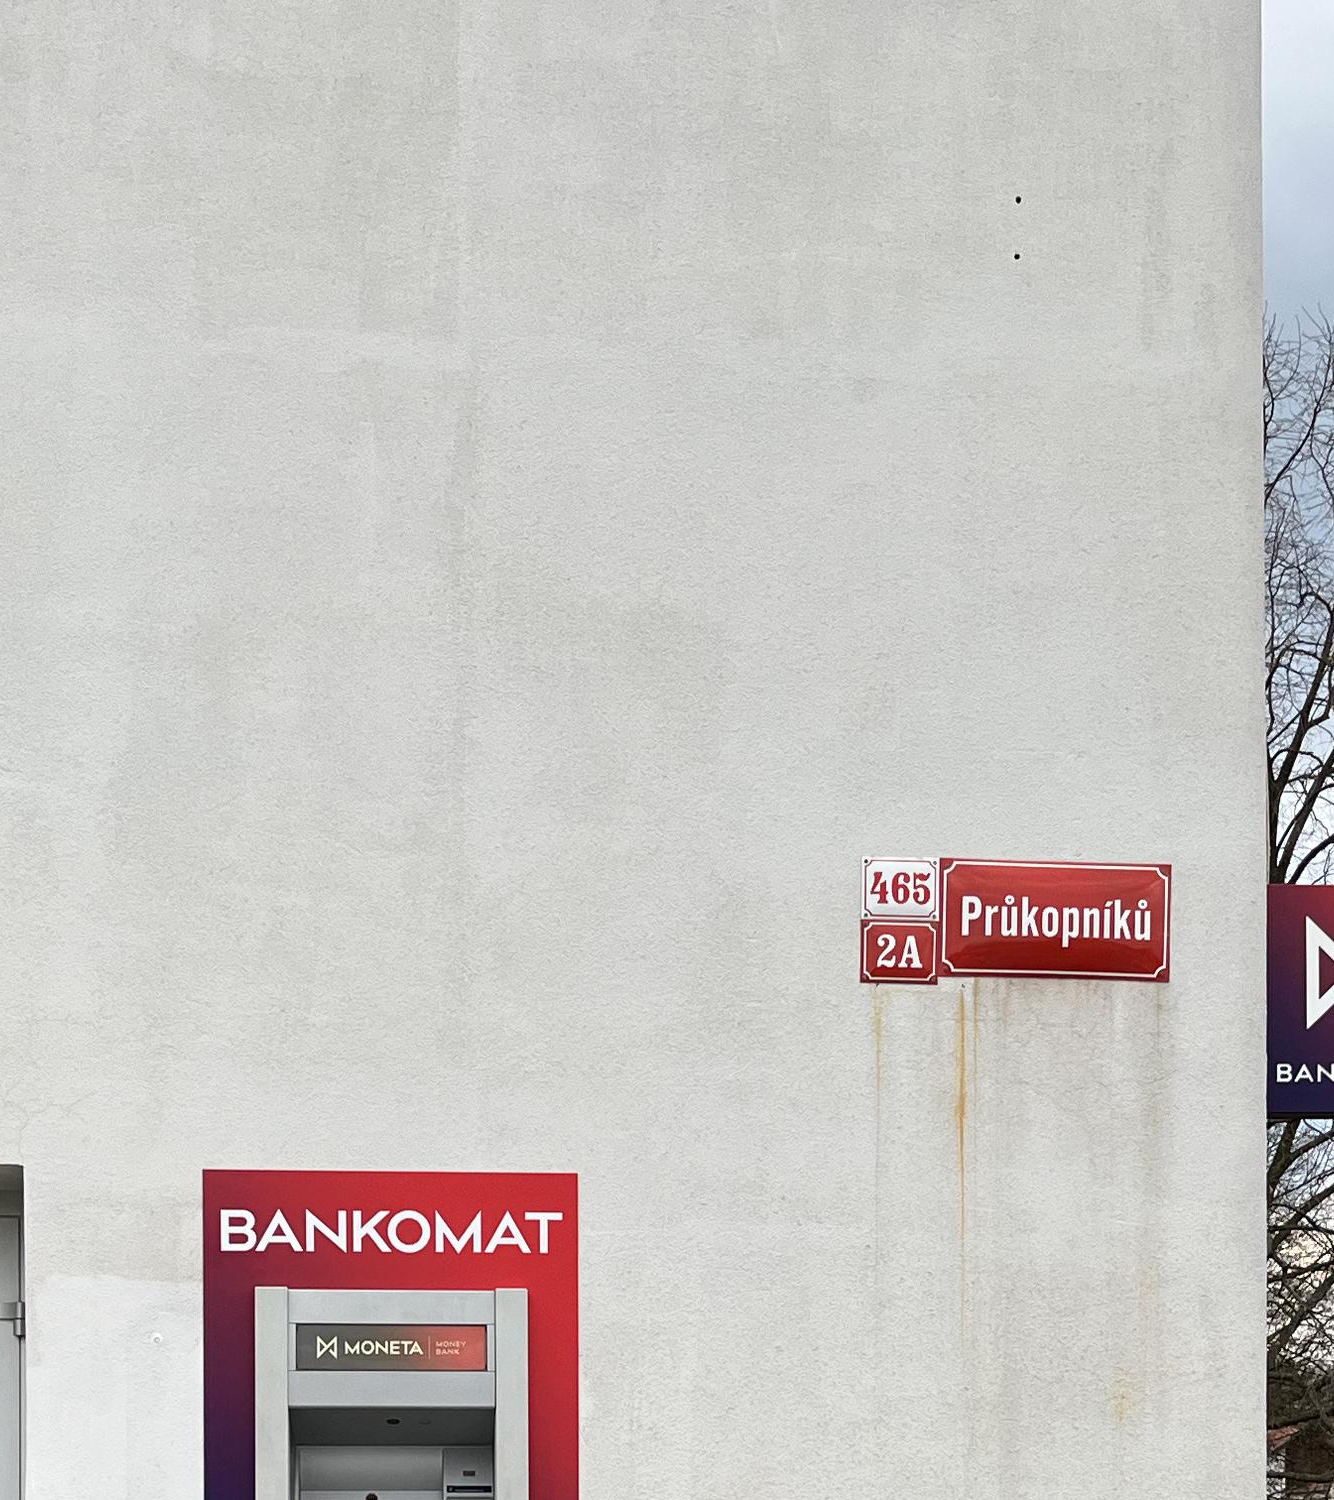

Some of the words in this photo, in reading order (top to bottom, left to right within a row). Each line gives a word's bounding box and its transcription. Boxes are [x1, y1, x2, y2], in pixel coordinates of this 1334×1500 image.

[869, 870, 932, 906] 465
[960, 894, 1152, 949] Průkopníků
[875, 934, 924, 970] 2A
[219, 1208, 564, 1255] BANKOMAT
[344, 1340, 424, 1356] MONETA
[435, 1340, 467, 1348] MONEY
[435, 1348, 460, 1356] BANK
